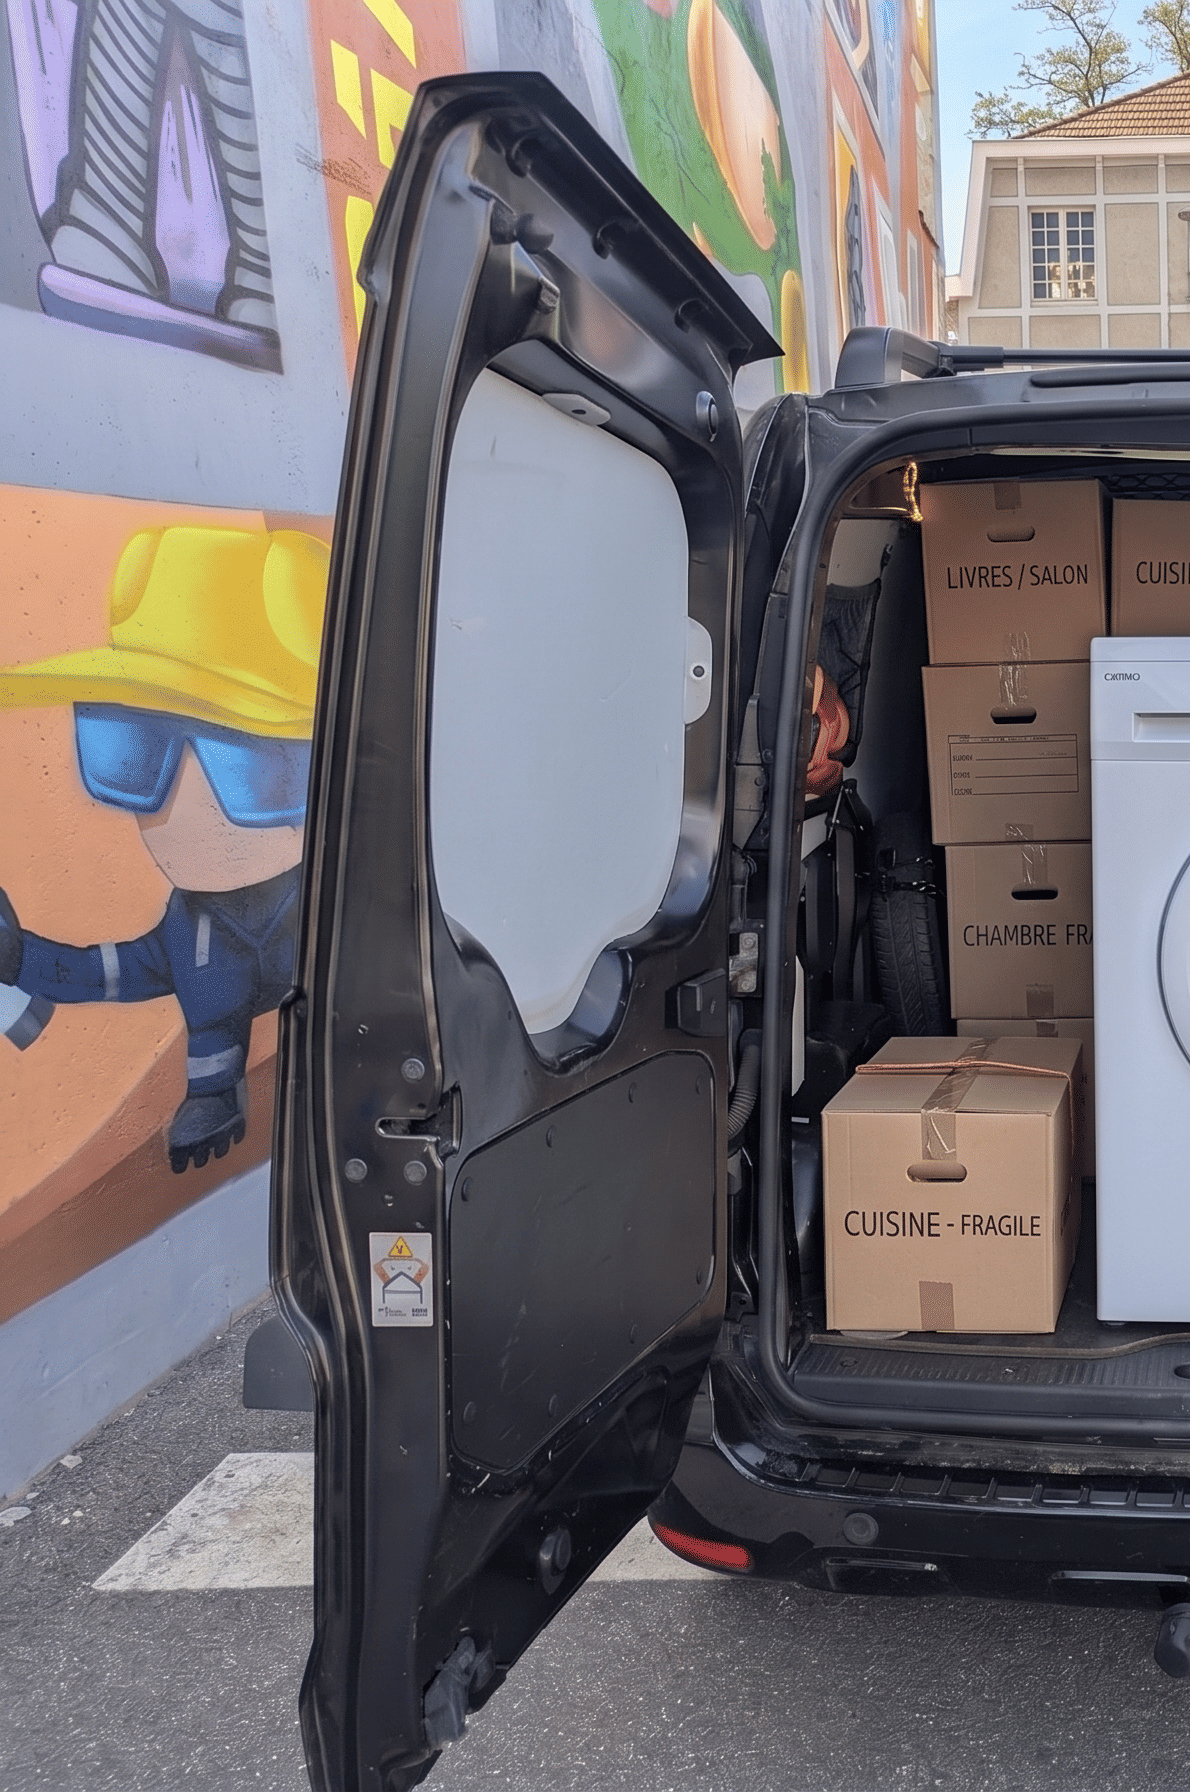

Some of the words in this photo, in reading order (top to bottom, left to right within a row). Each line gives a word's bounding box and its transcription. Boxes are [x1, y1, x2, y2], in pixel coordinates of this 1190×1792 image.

[946, 564, 1013, 589] LIVRES
[1029, 563, 1089, 587] SALON
[963, 924, 1057, 947] CHAMBRE
[843, 1210, 941, 1238] CUISINE
[960, 1213, 1042, 1237] FRAGILE
